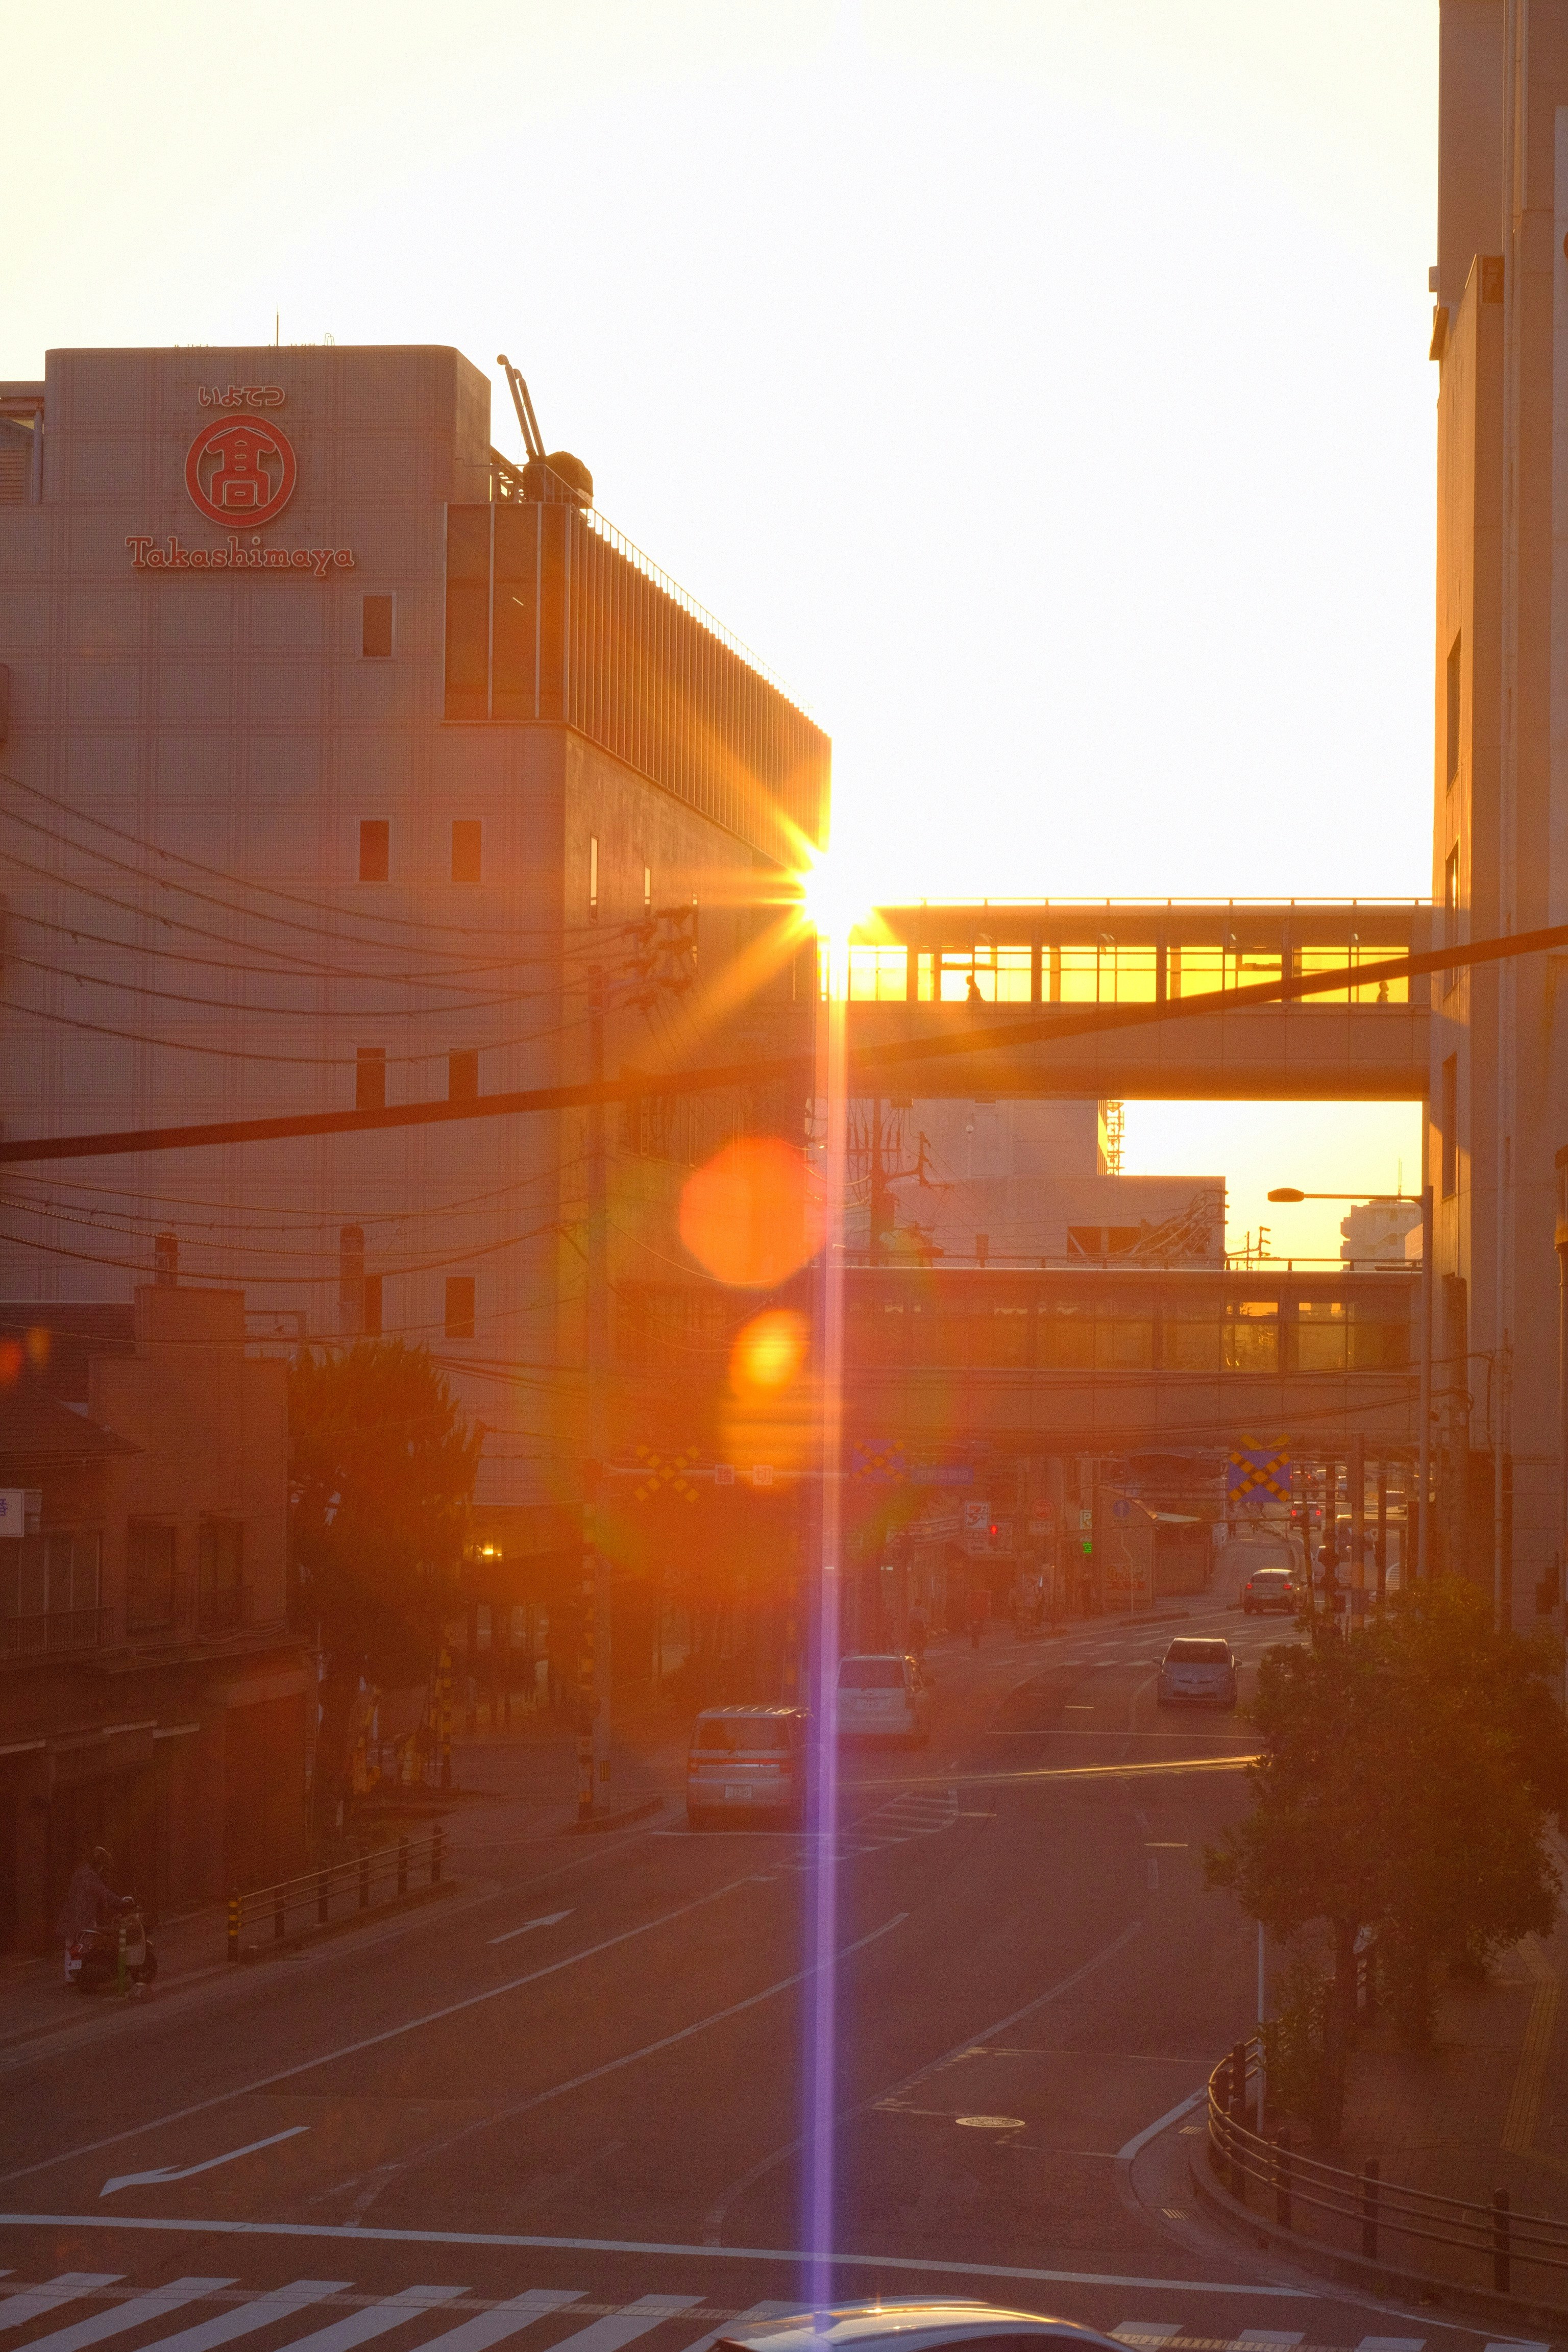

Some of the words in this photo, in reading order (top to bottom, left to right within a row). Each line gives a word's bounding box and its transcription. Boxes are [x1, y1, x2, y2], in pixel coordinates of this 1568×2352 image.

[198, 386, 285, 407] いよてつ
[125, 536, 355, 577] Takashimaya
